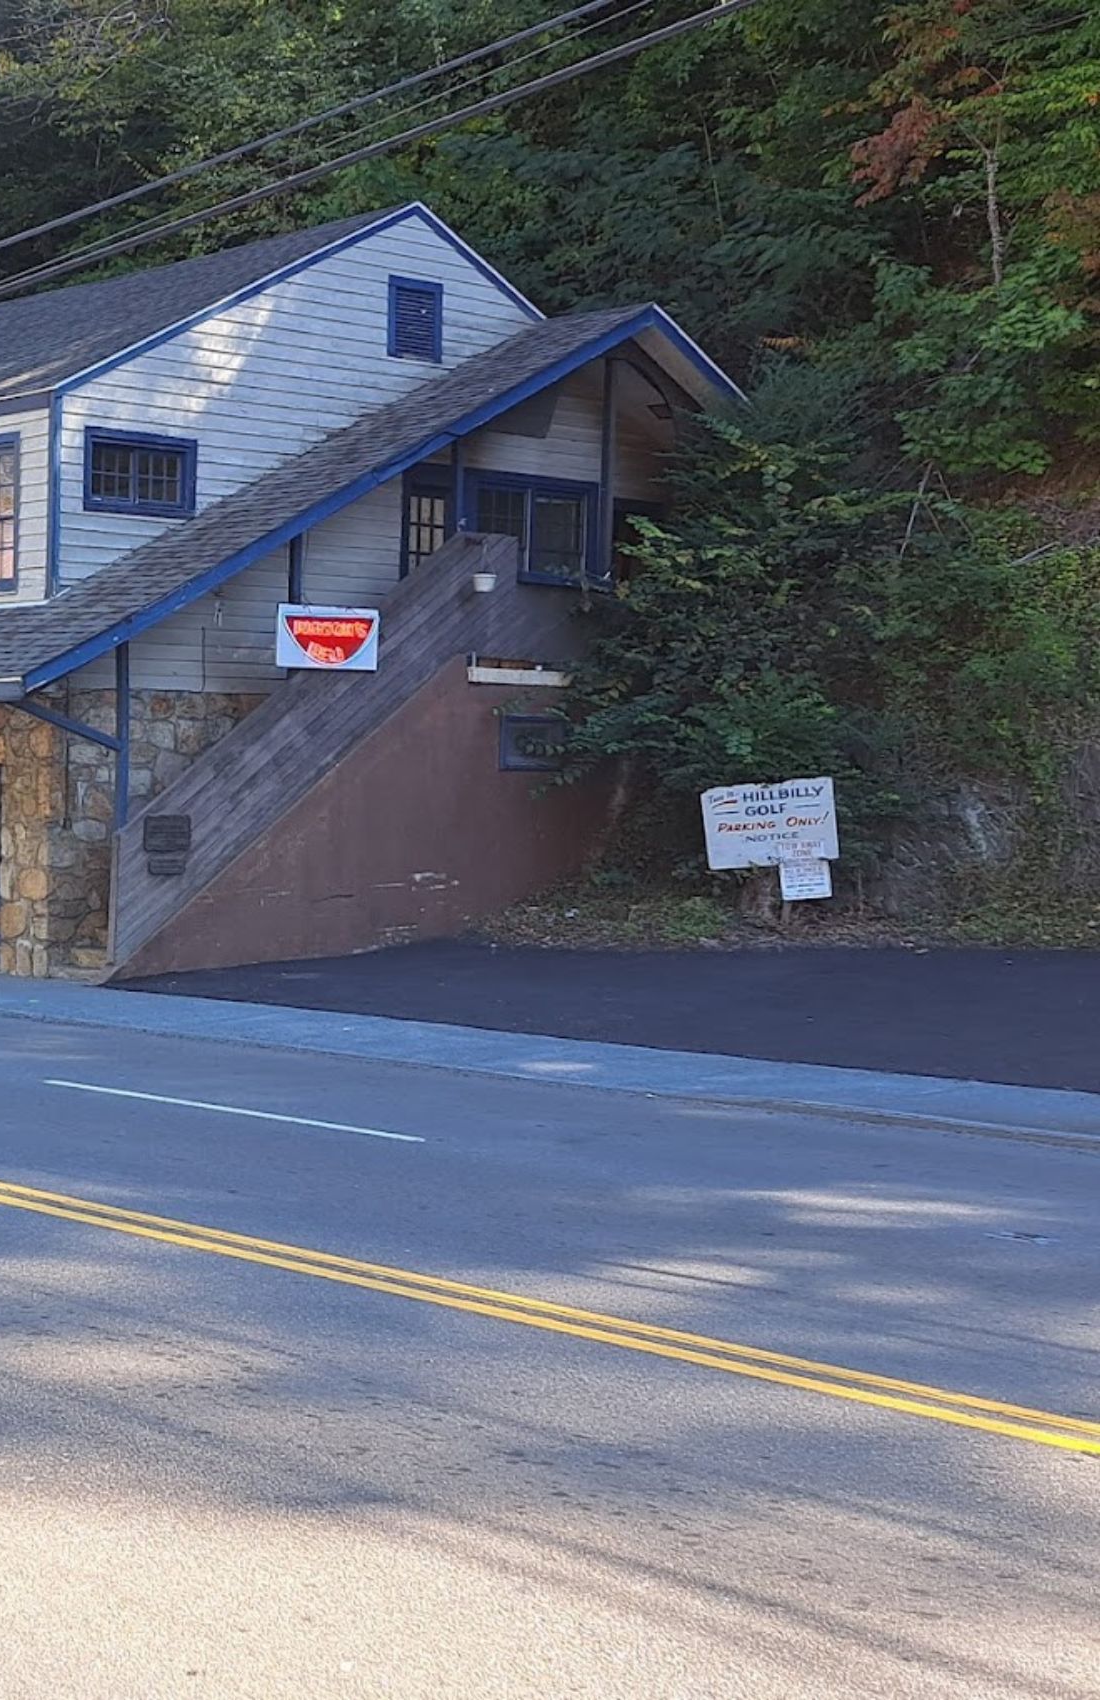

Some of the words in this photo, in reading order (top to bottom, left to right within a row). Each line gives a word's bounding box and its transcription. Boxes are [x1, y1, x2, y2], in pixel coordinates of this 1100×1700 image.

[743, 786, 824, 802] HILLBILLY
[745, 803, 787, 816] GOLF
[718, 821, 777, 832] PARKING
[786, 811, 830, 827] ONLY!
[745, 831, 800, 842] NOTICE
